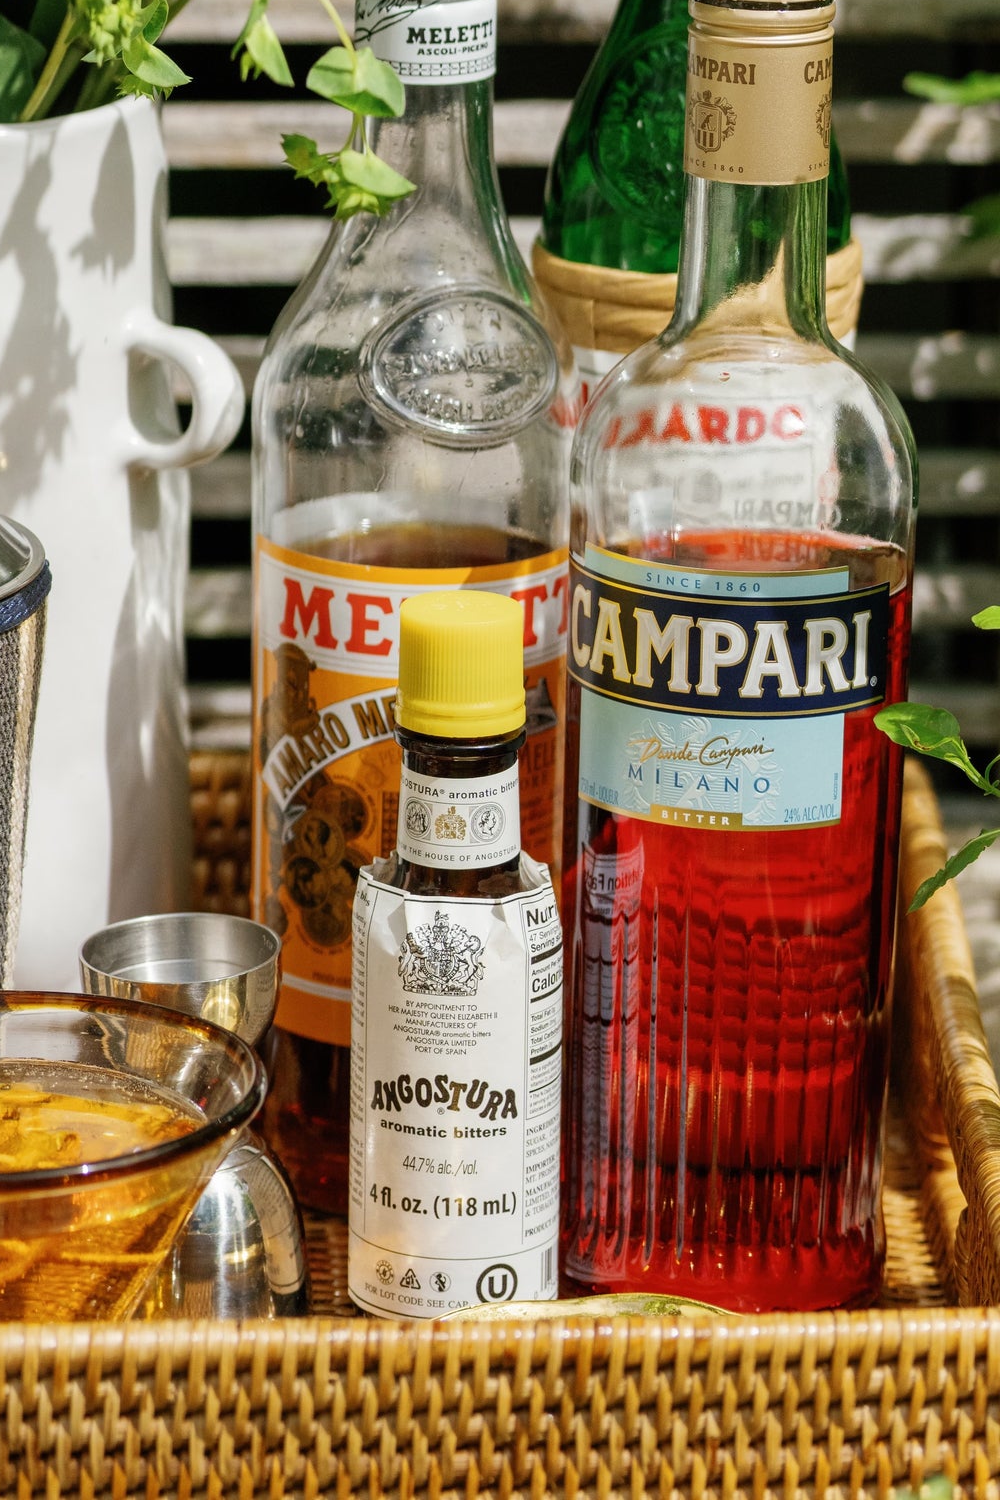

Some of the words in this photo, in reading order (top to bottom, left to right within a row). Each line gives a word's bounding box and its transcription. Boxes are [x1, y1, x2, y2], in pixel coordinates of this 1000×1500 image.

[713, 164, 745, 174] 1860
[645, 572, 702, 590] SINCE
[715, 581, 762, 593] 1860
[571, 583, 873, 699] CAMPARI
[269, 711, 352, 802] AMARO
[698, 736, 775, 770] Campari
[628, 763, 771, 795] MILANO
[448, 787, 498, 800] aromatic
[660, 809, 731, 826] BITTER
[783, 807, 801, 823] 24%
[408, 846, 422, 857] THE
[424, 852, 455, 862] HOUSE
[475, 844, 518, 861] ANGOSTURA
[388, 1005, 400, 1014] HER
[400, 1008, 429, 1018] MAJESTY
[430, 1012, 456, 1021] QUEEN
[457, 1013, 493, 1021] ELIZABETH
[405, 1000, 415, 1008] BY
[415, 1001, 466, 1012] APPOINTMENT
[405, 1018, 466, 1029] MANUFACTURERS
[466, 1021, 478, 1029] OF
[405, 1036, 450, 1046] ANGOSTURA
[451, 1039, 477, 1047] LIMITED
[414, 1046, 432, 1054] PORT
[433, 1047, 443, 1055] OF
[445, 1048, 467, 1056] SPAIN
[370, 1073, 519, 1121] ANGOSTURA
[380, 1118, 448, 1138] aromatic
[453, 1126, 508, 1138] bitters
[402, 1155, 435, 1174] 44.7%
[369, 1183, 378, 1203] 4
[380, 1185, 397, 1210] fl.
[401, 1196, 428, 1215] oz.
[433, 1195, 478, 1219] (118
[483, 1191, 517, 1216] mL)
[364, 1282, 379, 1296] FOR
[379, 1289, 397, 1301] LOT
[397, 1295, 424, 1307] CODE
[426, 1298, 445, 1309] SEE
